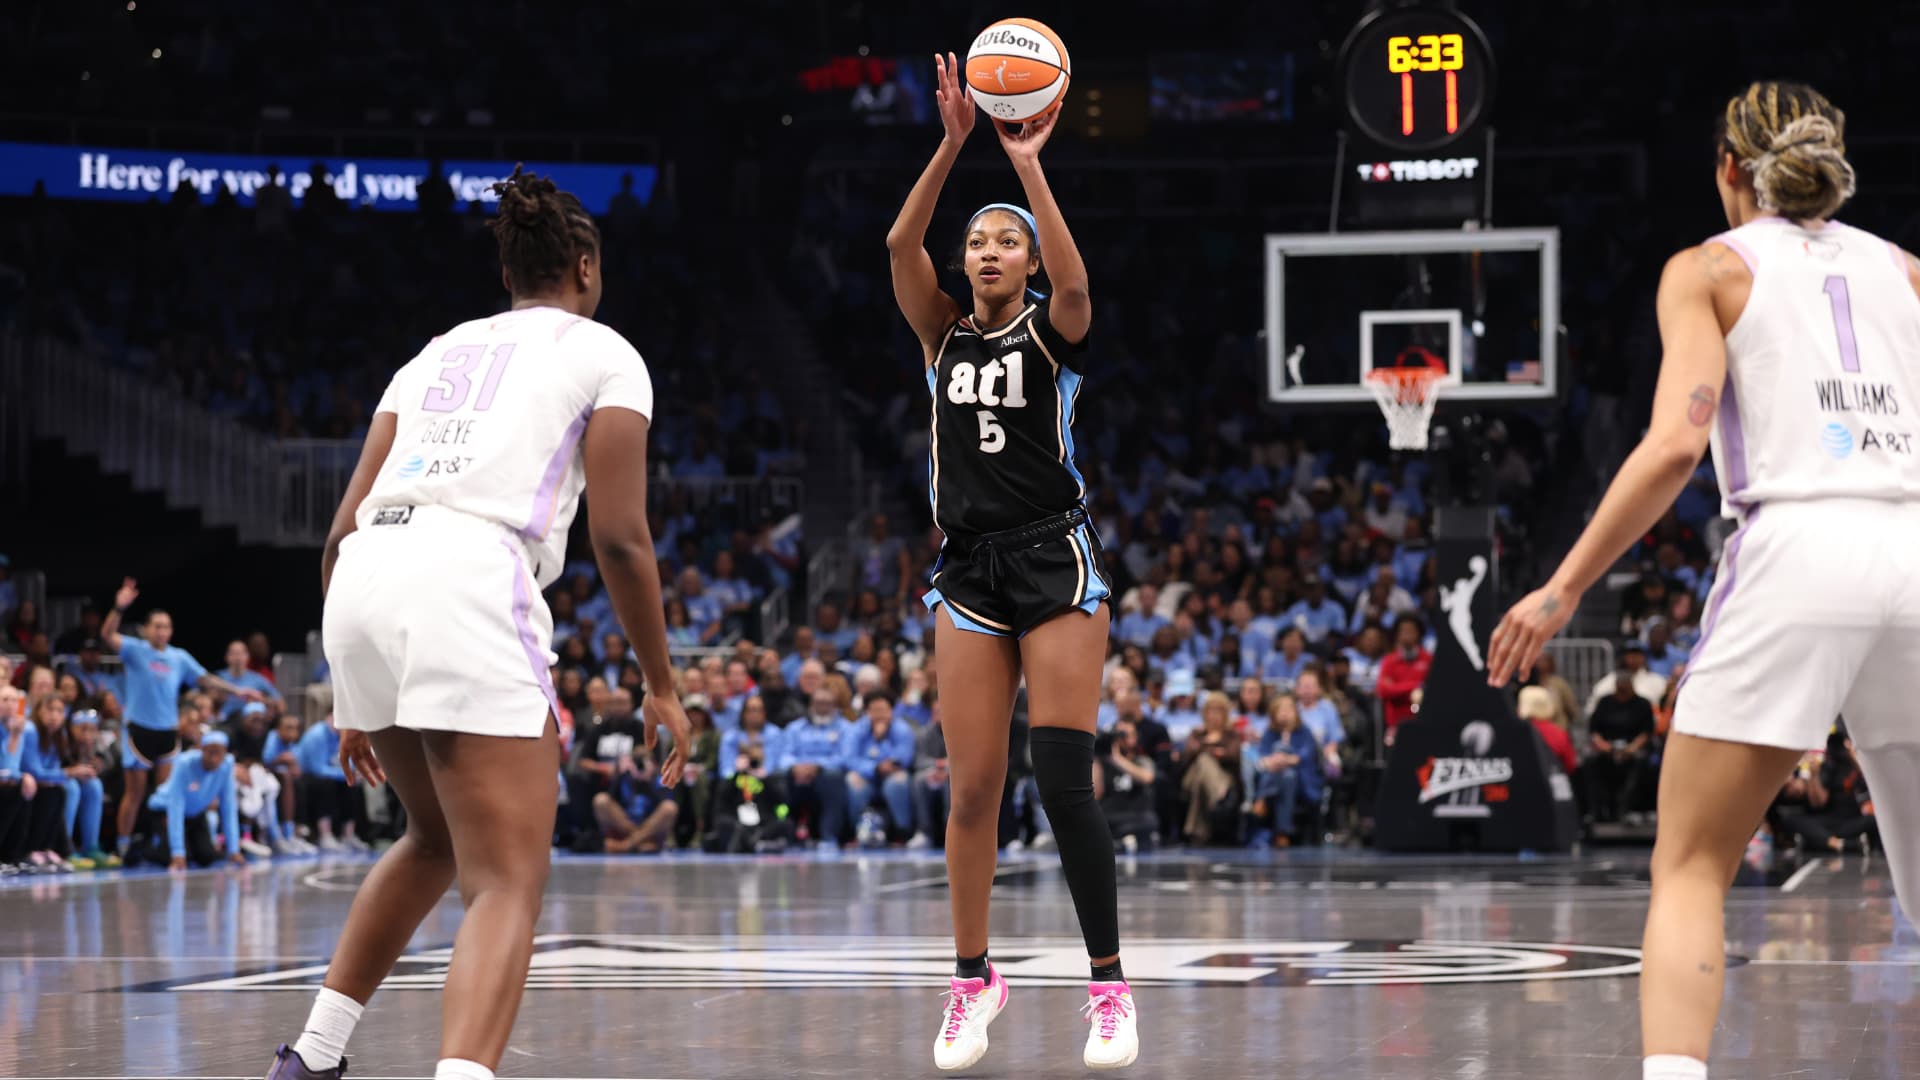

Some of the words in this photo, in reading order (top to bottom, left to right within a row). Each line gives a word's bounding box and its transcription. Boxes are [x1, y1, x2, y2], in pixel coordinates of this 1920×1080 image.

[976, 30, 1041, 54] Wilson
[1388, 34, 1464, 73] 6:33
[1401, 70, 1458, 136] 11
[80, 152, 163, 192] Here
[167, 157, 219, 195] for
[222, 170, 286, 198] yo
[290, 162, 357, 200] ad
[362, 174, 424, 206] you
[448, 171, 508, 203] tea
[1389, 157, 1479, 182] TISSOT
[1000, 331, 1029, 348] Albert
[1823, 275, 1861, 373] 1
[421, 343, 517, 413] 31
[947, 350, 1028, 408] atl
[1815, 379, 1900, 416] WILIAMS
[421, 418, 477, 444] GUEYE
[975, 410, 1006, 454] 5
[1861, 426, 1913, 454] A&T
